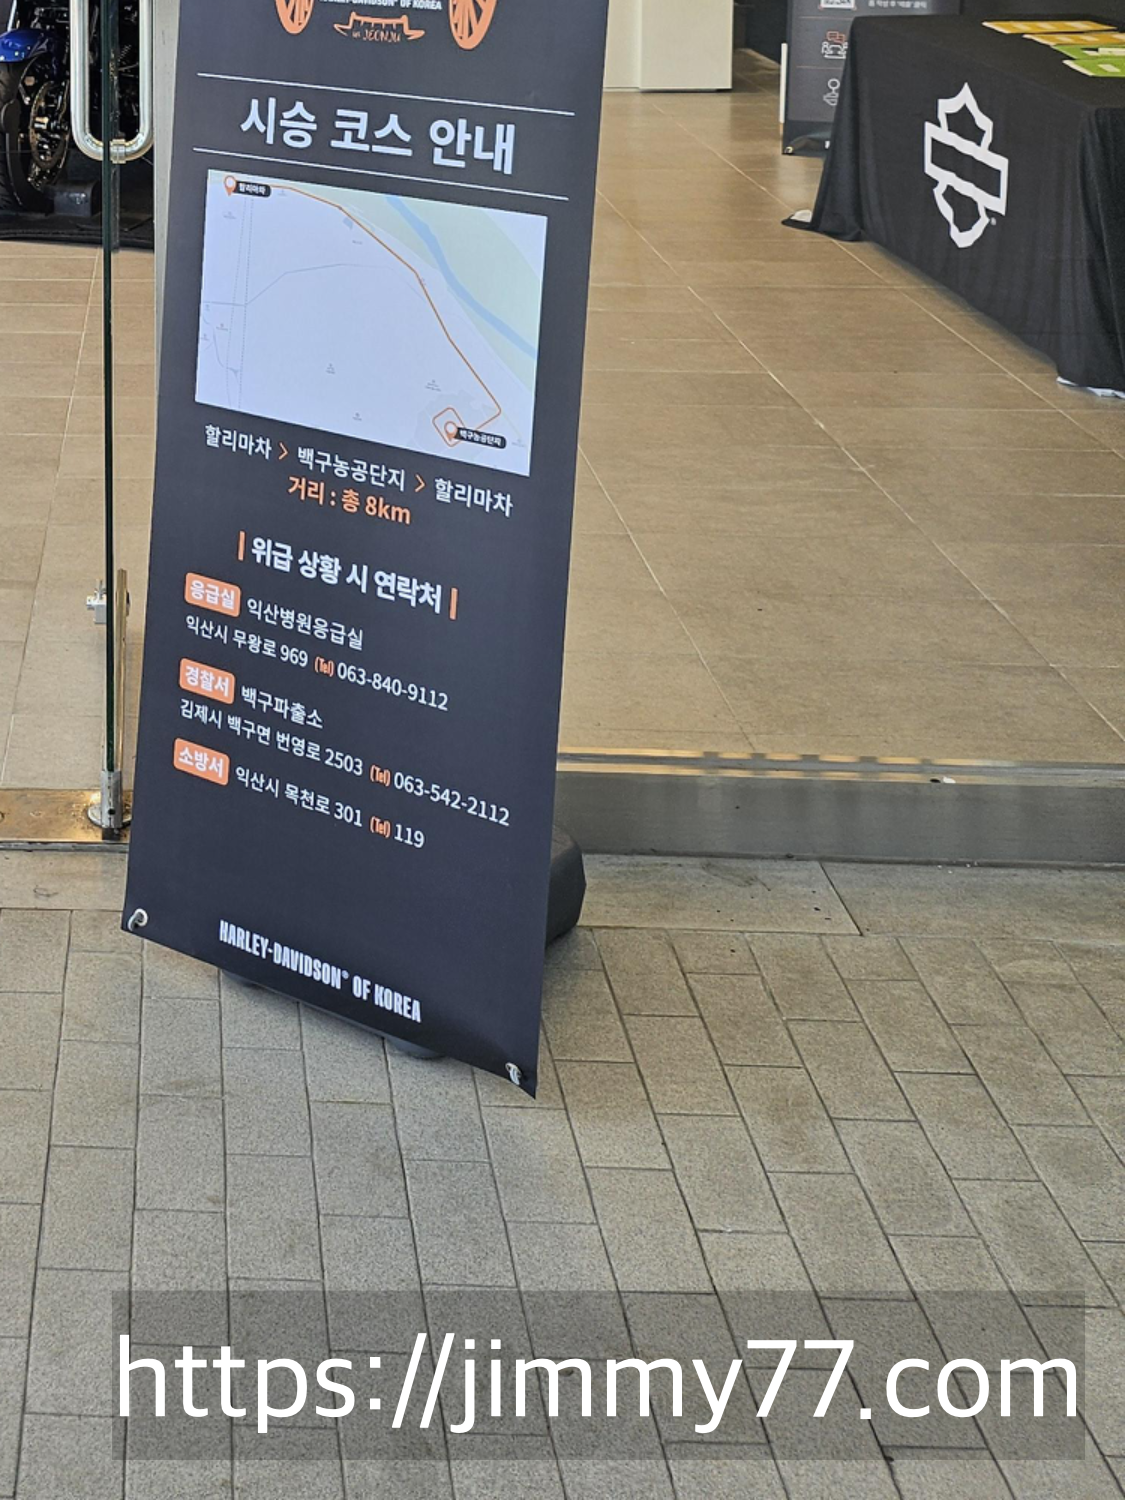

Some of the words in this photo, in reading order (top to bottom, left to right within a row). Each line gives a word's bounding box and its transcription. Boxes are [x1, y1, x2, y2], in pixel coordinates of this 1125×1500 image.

[412, 0, 442, 10] KOREA
[240, 97, 317, 148] 시승
[330, 108, 413, 157] 코스
[429, 118, 516, 175] 안내
[204, 424, 272, 460] 할리마차
[297, 446, 406, 492] 백구농공단지
[434, 477, 513, 518] 할리마차
[287, 476, 325, 505] 거리
[341, 488, 361, 513] 총
[366, 495, 411, 525] 8km
[251, 537, 293, 573] 위급
[298, 550, 342, 585] 상황
[345, 564, 368, 594] 시
[374, 570, 442, 614] 연락처
[190, 579, 236, 610] 응급실
[247, 598, 364, 651] 익산병원응급실
[185, 665, 230, 697] 경찰서
[241, 685, 324, 730] 백구파출소
[186, 615, 228, 645] 익산시
[232, 629, 277, 658] 무왕로
[280, 644, 309, 667] 969
[337, 662, 449, 712] 063-840-9112
[178, 746, 225, 779] 소방서
[235, 766, 280, 799] 익산시
[284, 782, 331, 815] 목천로
[333, 801, 363, 828] 301
[393, 824, 426, 849] 119
[180, 698, 223, 730] 김제시
[227, 714, 271, 746] 백구면
[276, 731, 321, 762] 번영로
[324, 748, 364, 777] 2503
[393, 771, 511, 827] 063-542-2112
[352, 975, 372, 1001] OF
[374, 983, 422, 1024] KOREA
